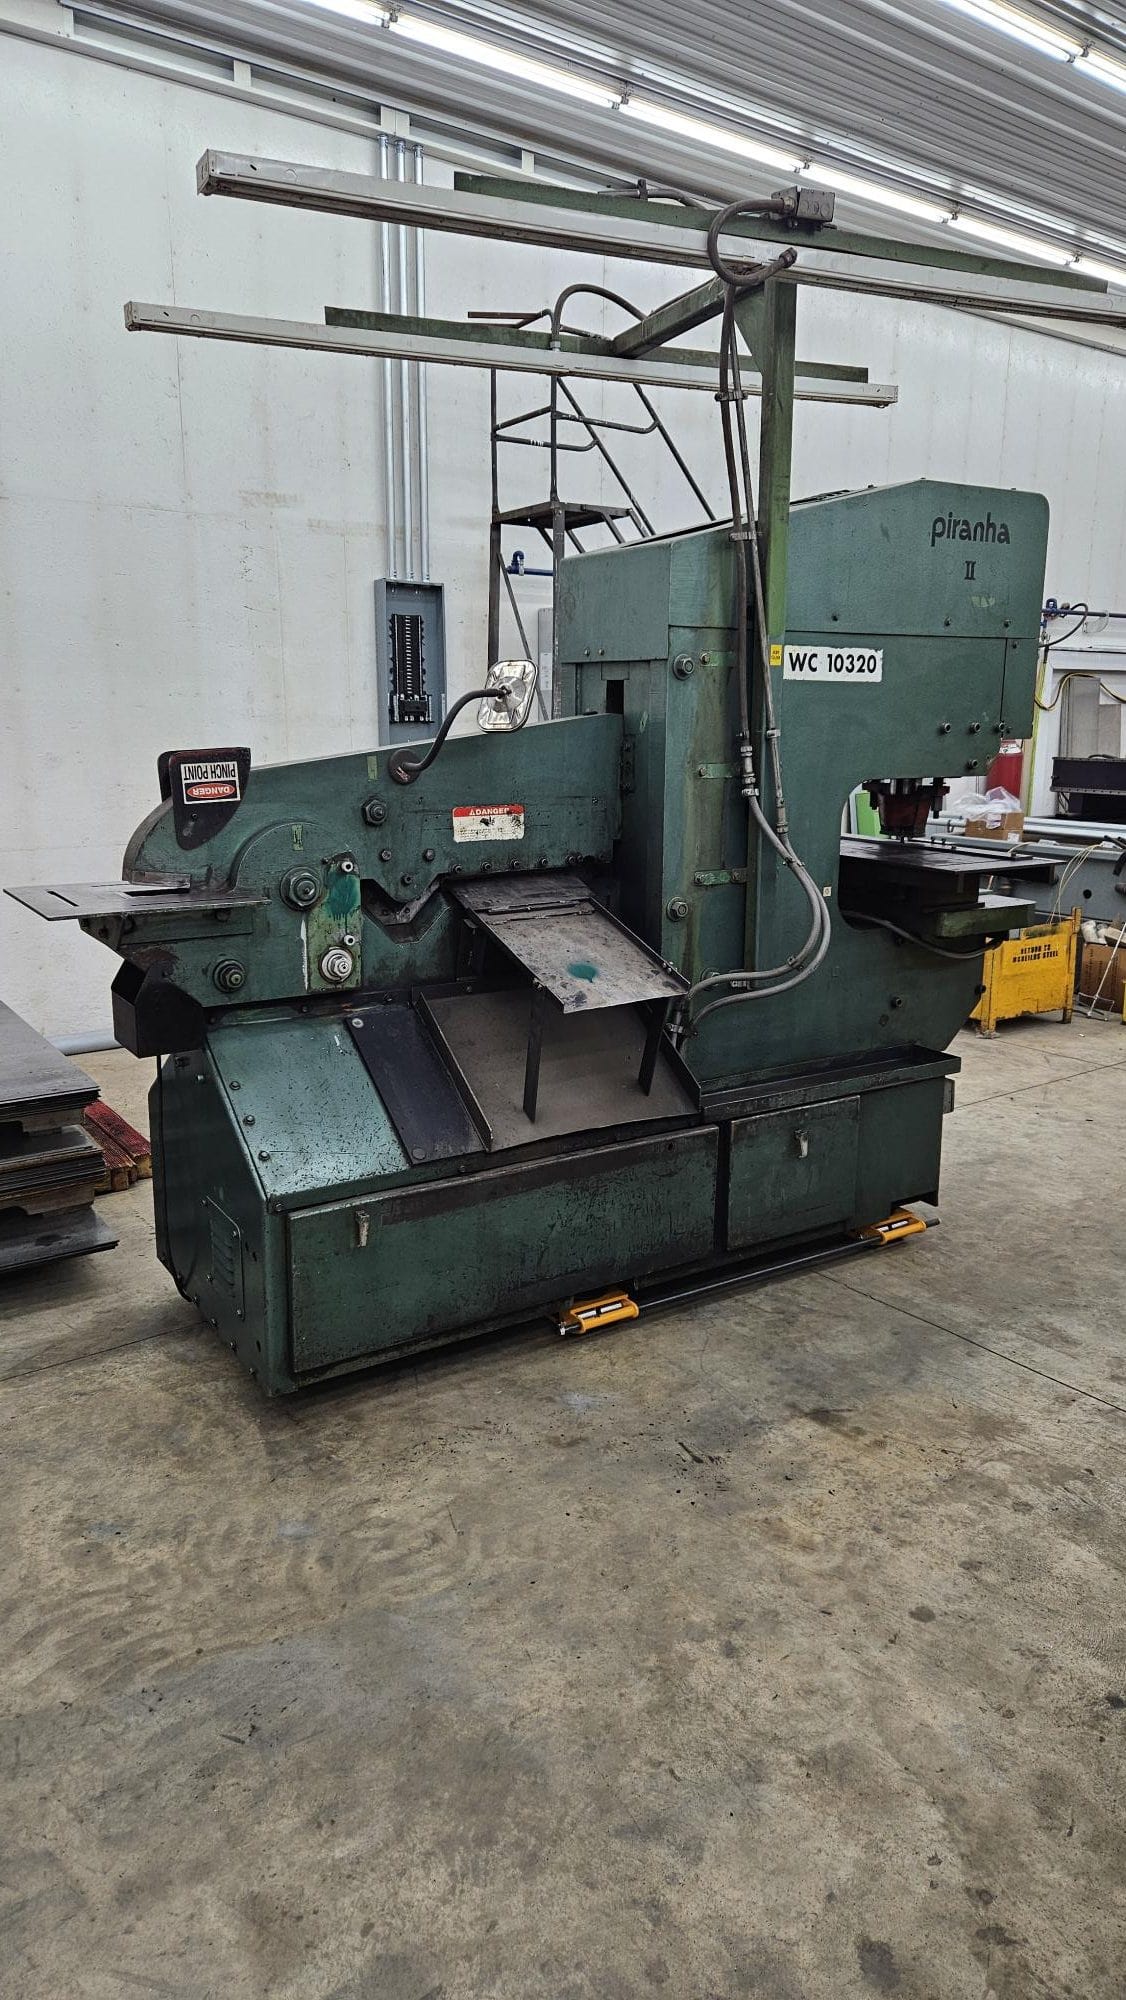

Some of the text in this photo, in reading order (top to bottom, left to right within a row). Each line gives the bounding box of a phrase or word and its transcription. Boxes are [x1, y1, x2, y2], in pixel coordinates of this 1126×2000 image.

[931, 511, 1011, 547] piranha
[964, 560, 977, 580] II
[788, 652, 877, 674] WC 10320
[183, 763, 236, 781] PINCH POINT
[192, 786, 230, 796] DANGER
[1042, 950, 1059, 959] STEEL
